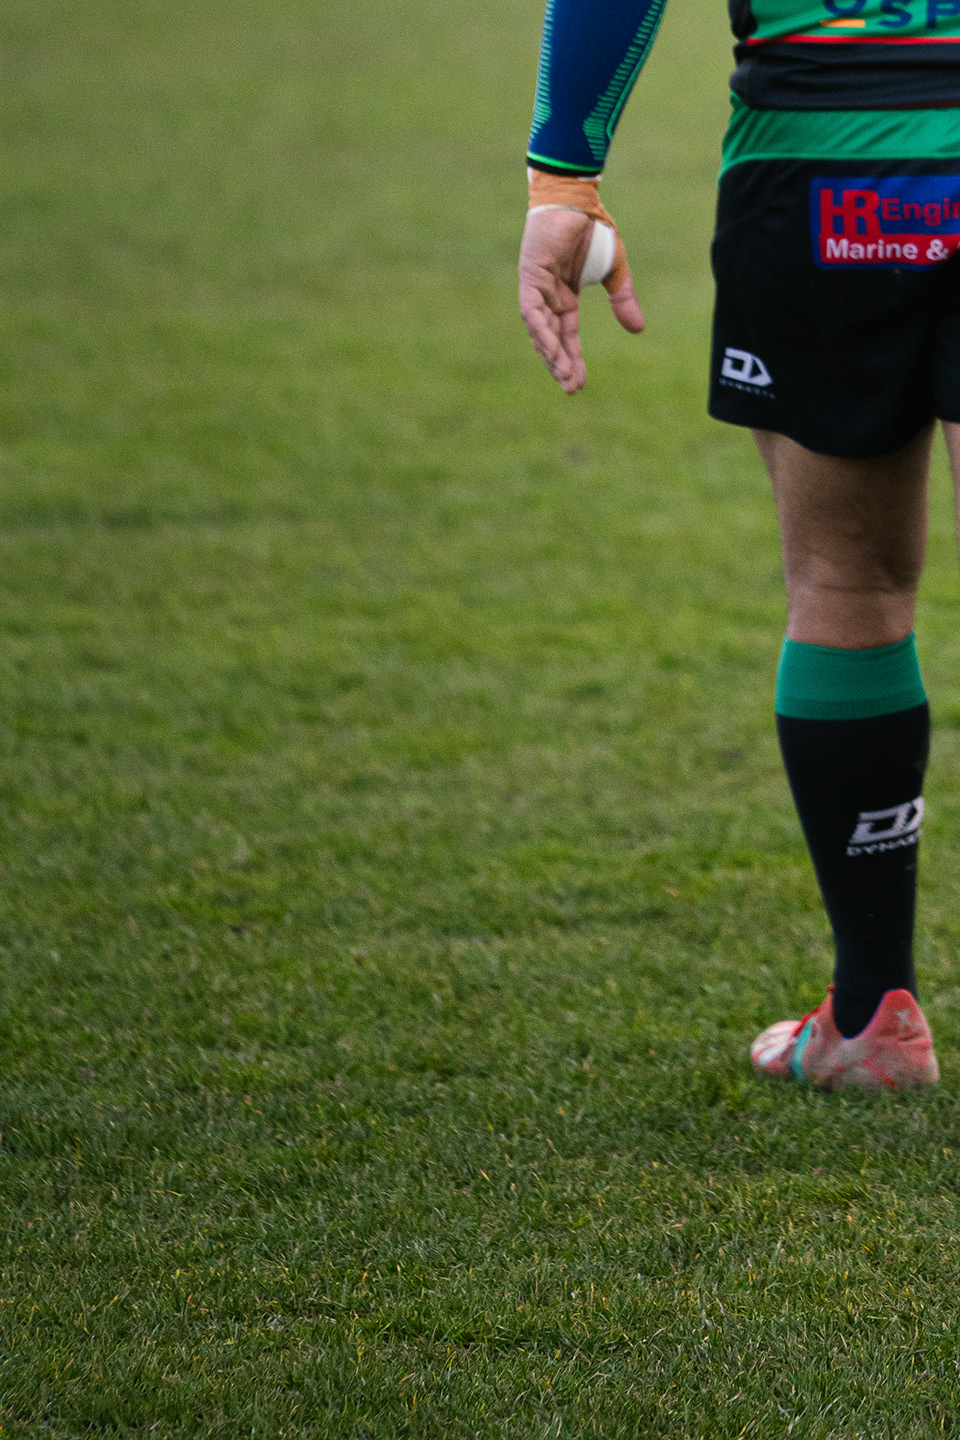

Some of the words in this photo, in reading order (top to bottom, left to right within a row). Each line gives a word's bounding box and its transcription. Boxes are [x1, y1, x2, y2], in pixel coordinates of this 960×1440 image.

[819, 188, 882, 235] HR
[826, 237, 919, 260] Marine
[926, 238, 950, 261] &
